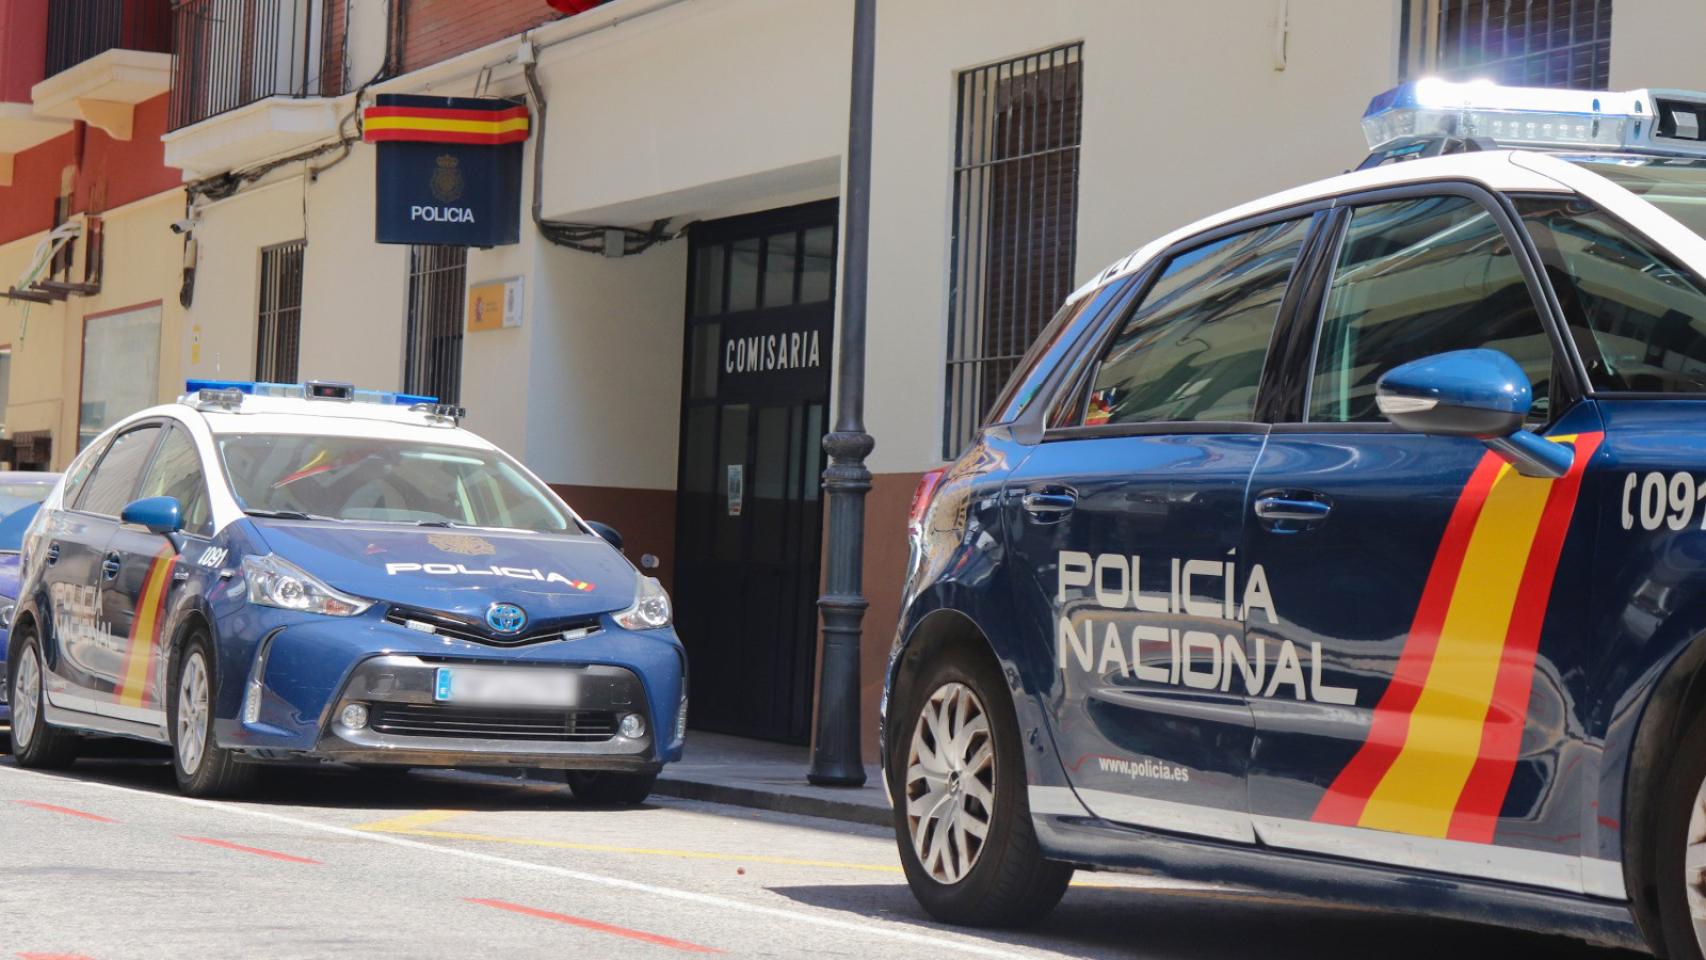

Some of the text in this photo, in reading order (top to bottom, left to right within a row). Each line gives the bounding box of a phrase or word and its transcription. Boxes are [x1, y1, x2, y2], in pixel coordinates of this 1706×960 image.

[411, 206, 475, 224] POLICIA
[725, 329, 820, 374] COMISARIA
[385, 562, 575, 587] POLICIA
[1058, 547, 1279, 624] POLICÍA
[1059, 616, 1358, 706] NACIONAL
[1098, 757, 1189, 782] www.policia.es
